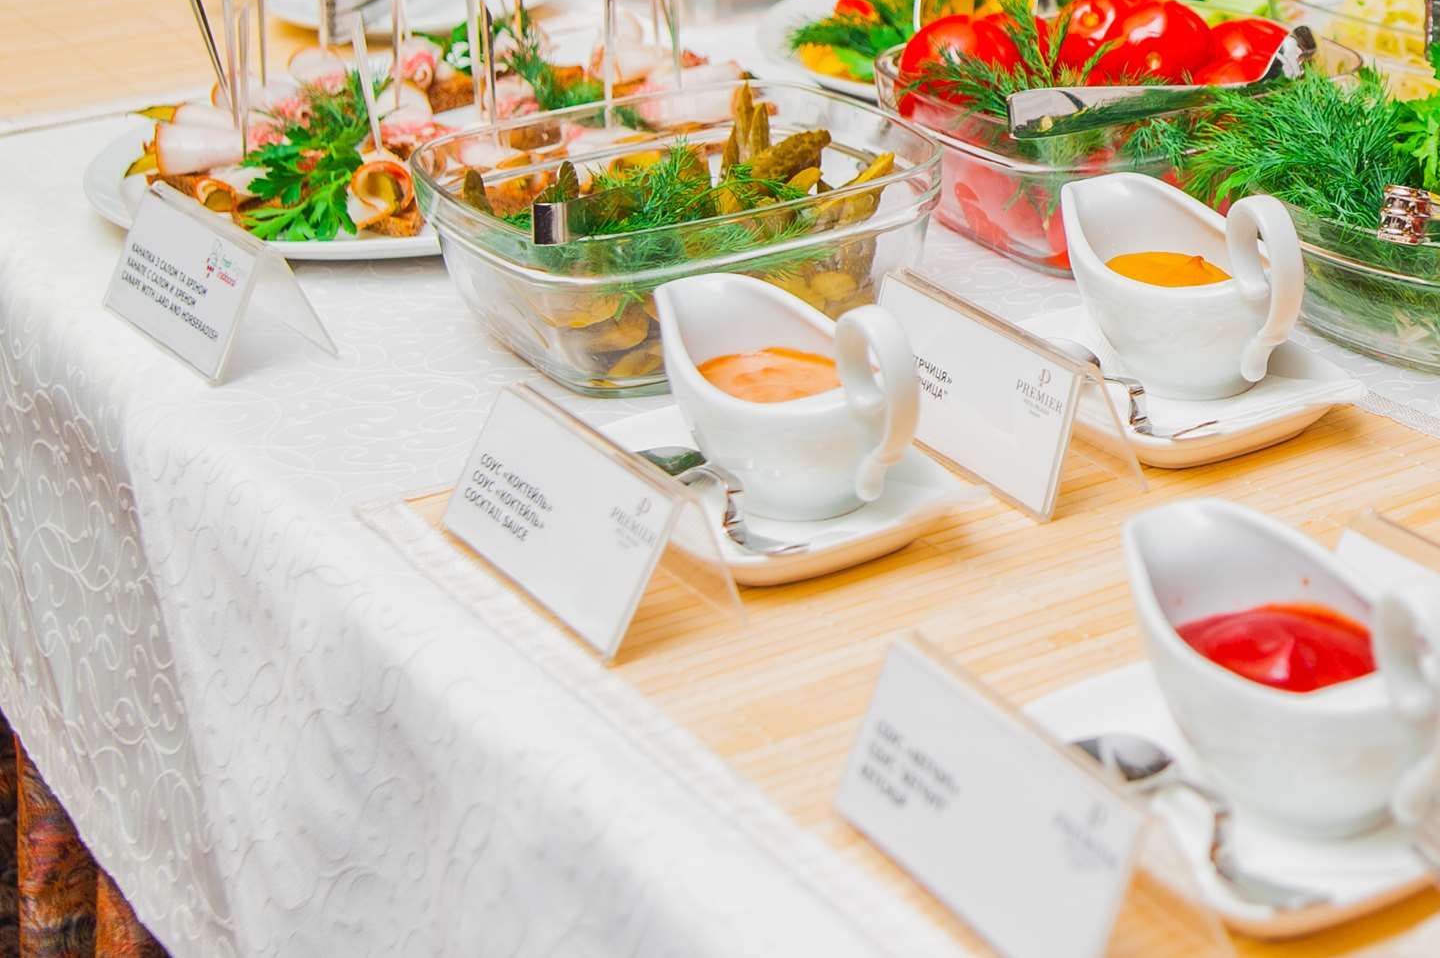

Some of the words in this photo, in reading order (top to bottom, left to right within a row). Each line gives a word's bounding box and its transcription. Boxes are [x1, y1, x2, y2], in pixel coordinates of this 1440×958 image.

[480, 453, 502, 476] СОУС
[472, 470, 495, 492] СОУС
[464, 486, 500, 522] COCKTAIL
[502, 514, 528, 542] SAUCE
